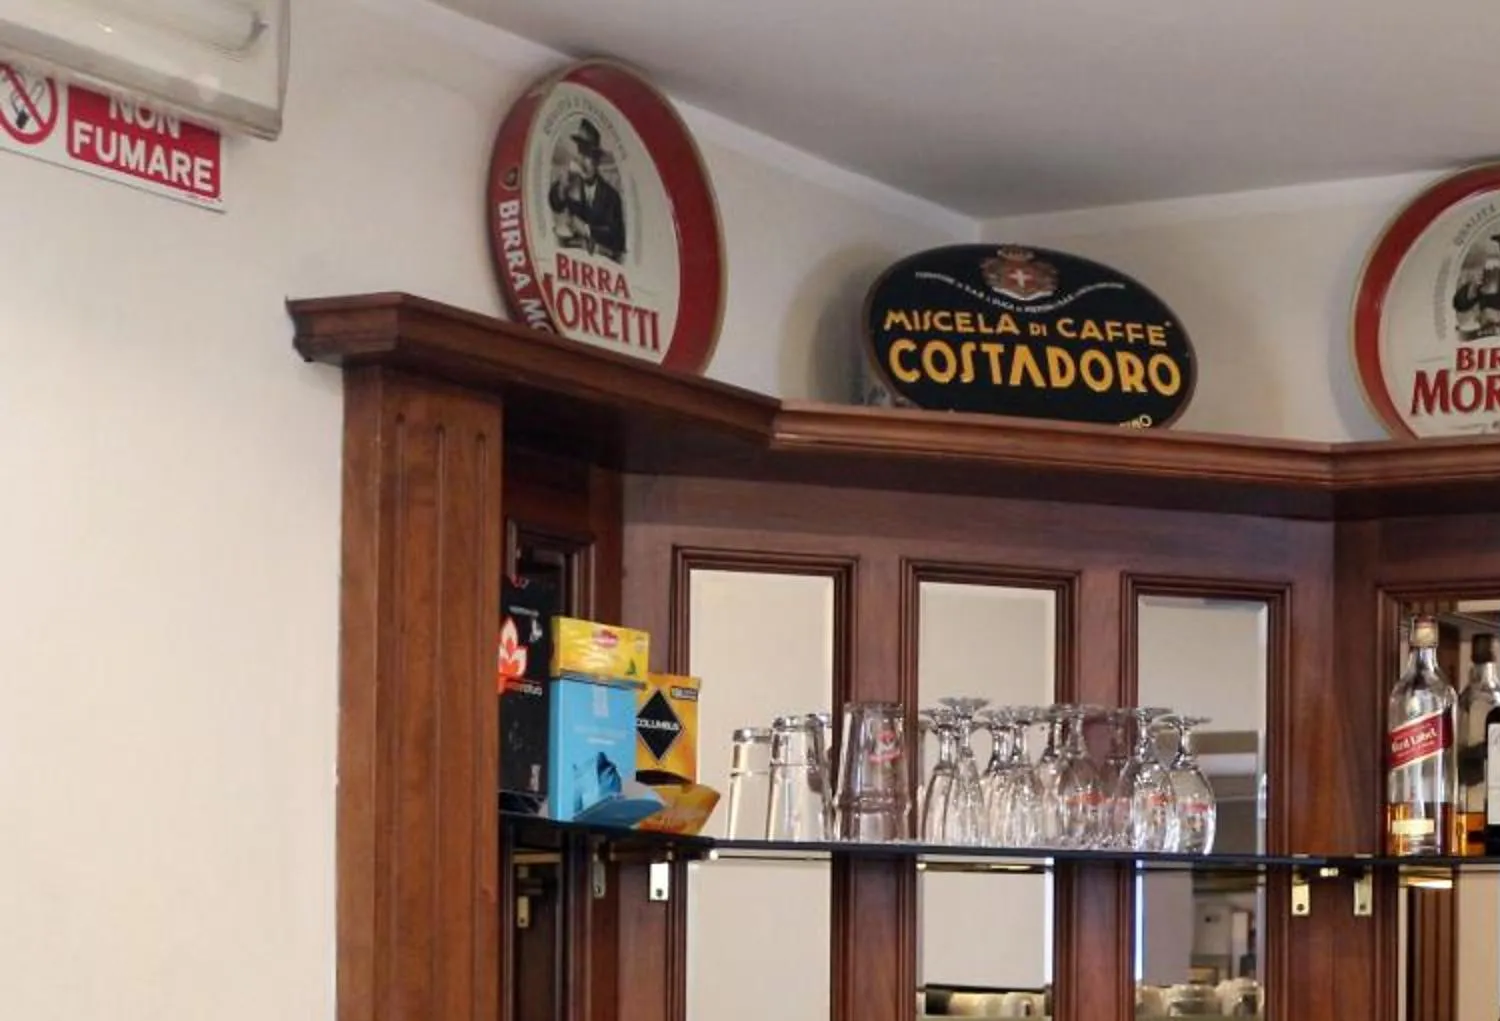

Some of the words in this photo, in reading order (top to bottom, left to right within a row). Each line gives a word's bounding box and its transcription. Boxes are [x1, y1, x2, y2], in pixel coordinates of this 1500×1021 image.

[109, 96, 183, 139] NON
[72, 120, 215, 193] FUMARE
[498, 200, 531, 292] BIRRA
[555, 252, 631, 298] BIRRA
[884, 308, 1020, 335] MISCELA
[1029, 322, 1047, 336] DI
[889, 338, 1181, 397] COSTADORO
